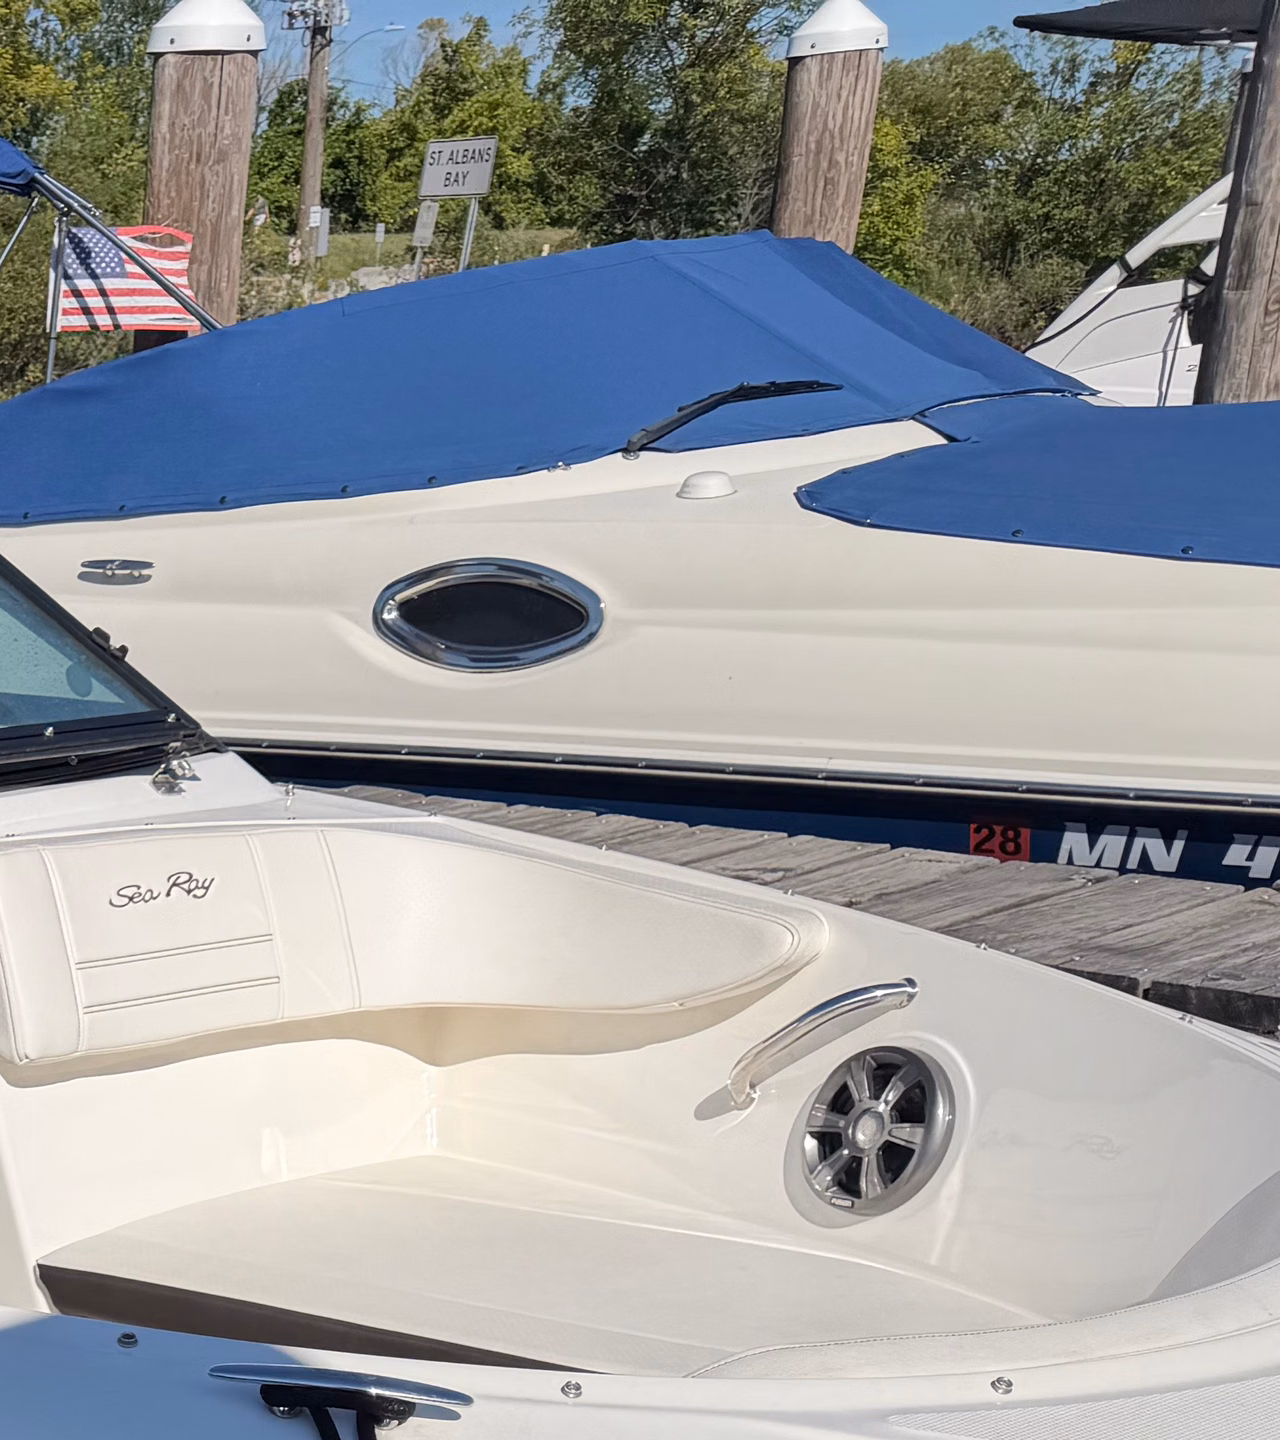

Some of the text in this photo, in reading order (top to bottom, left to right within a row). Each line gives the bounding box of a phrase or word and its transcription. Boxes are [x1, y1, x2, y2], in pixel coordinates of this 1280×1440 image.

[428, 147, 492, 166] ST. ALBANS
[443, 171, 469, 187] BAY
[972, 821, 1280, 879] 28 MN 4
[109, 871, 216, 909] Sea Ray
